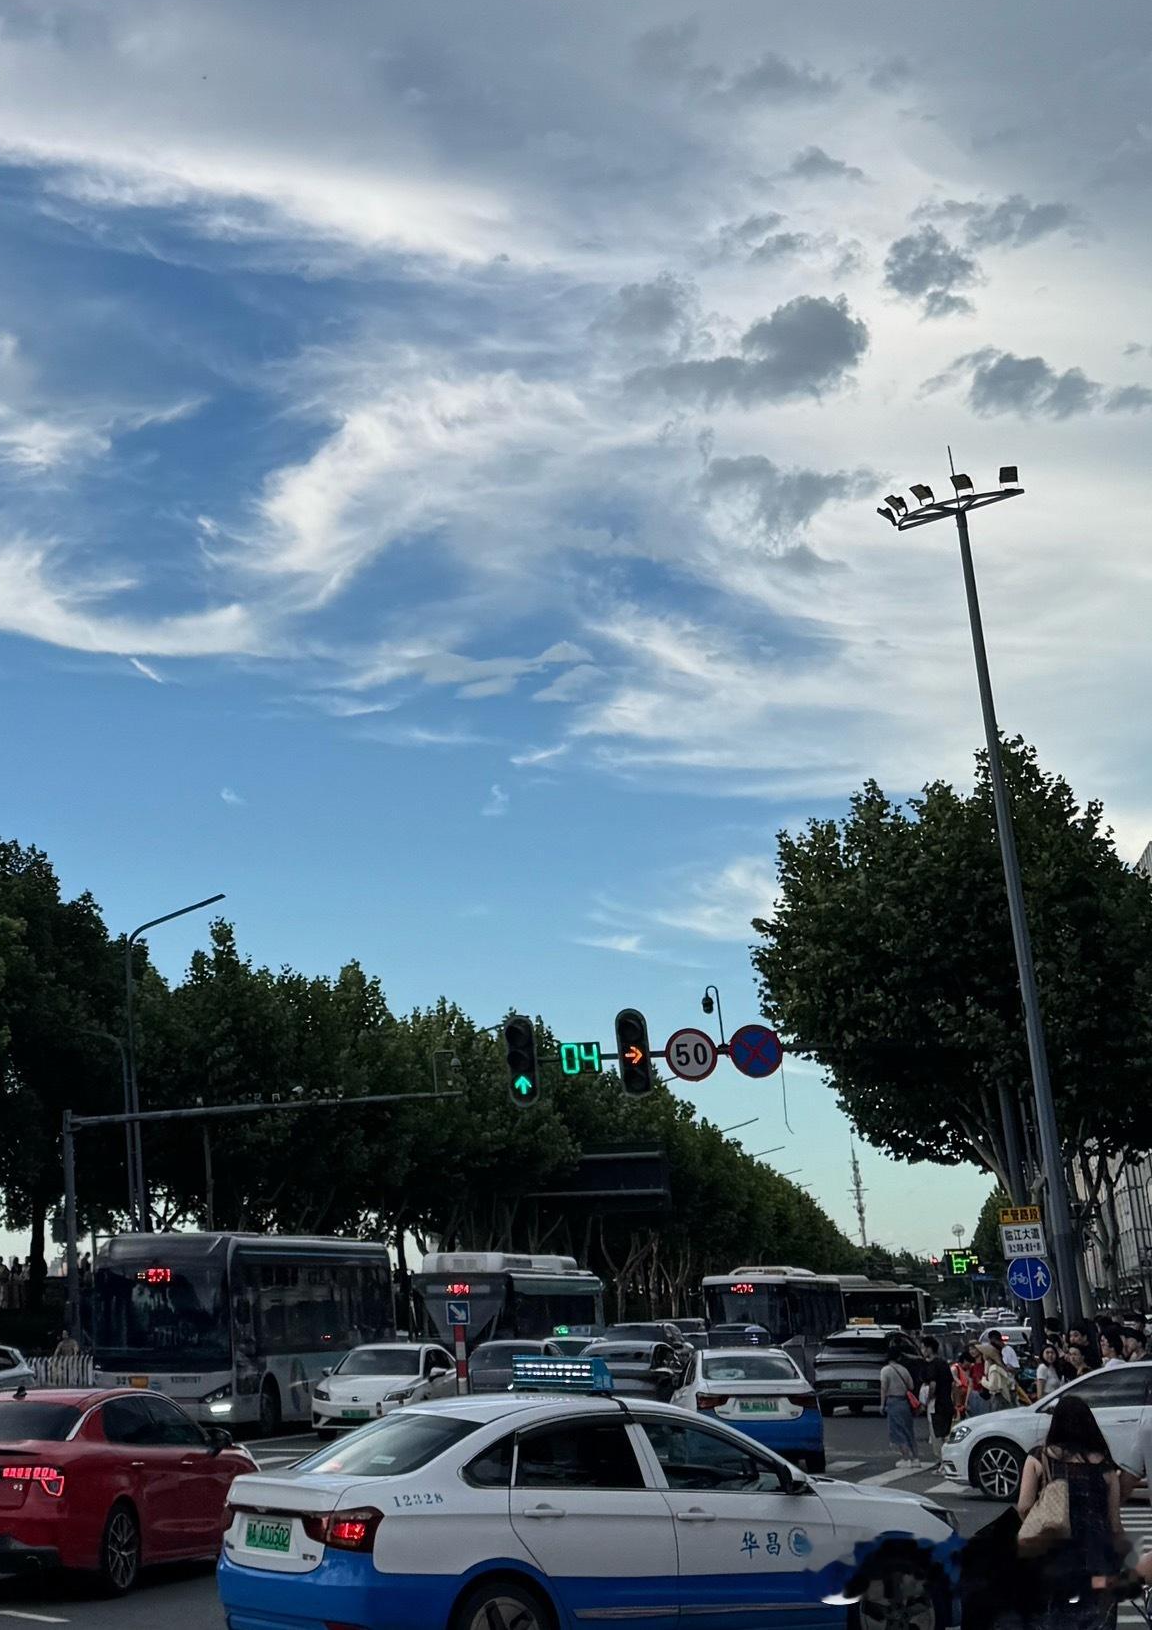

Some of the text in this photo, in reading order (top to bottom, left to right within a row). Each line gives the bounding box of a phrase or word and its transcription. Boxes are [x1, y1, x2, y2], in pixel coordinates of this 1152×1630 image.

[560, 1043, 599, 1075] 04
[675, 1042, 708, 1067] 50
[740, 1531, 781, 1559] 华昌
